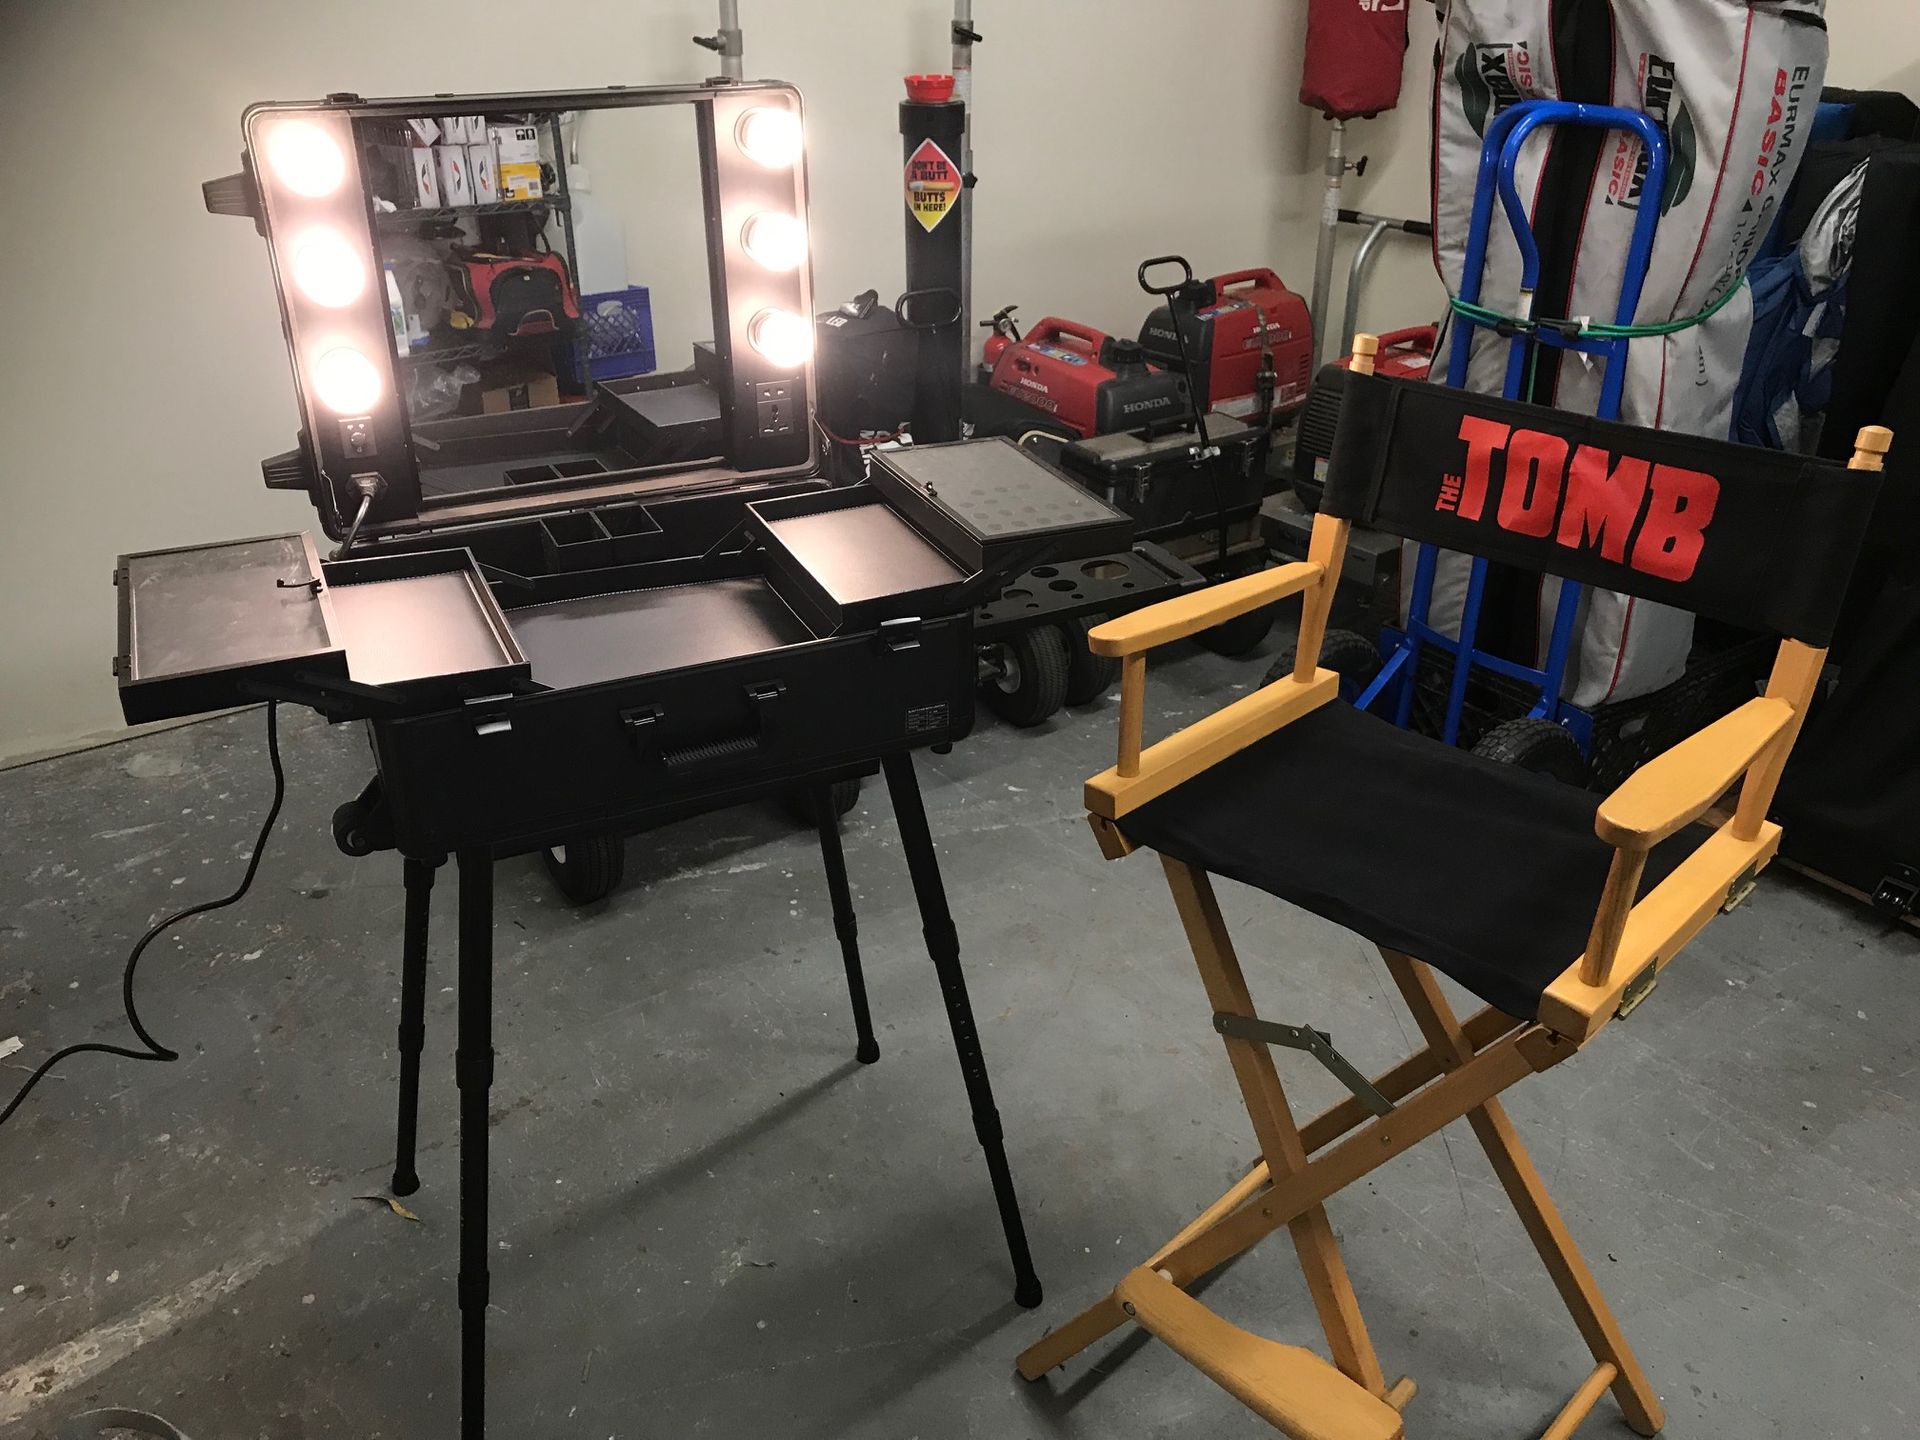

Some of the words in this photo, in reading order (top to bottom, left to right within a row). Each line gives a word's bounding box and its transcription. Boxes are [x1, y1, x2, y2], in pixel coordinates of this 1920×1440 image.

[1751, 68, 1788, 196] BASIC
[1768, 66, 1810, 188] EURMAX
[911, 160, 934, 171] DON'T
[936, 160, 948, 170] BE
[920, 170, 949, 181] BUTT
[913, 191, 946, 203] BUTTS
[913, 203, 921, 212] IN
[923, 203, 946, 212] HERE!
[1149, 326, 1190, 344] HON
[1020, 377, 1049, 394] HONDA
[1123, 396, 1171, 414] HONDA
[1434, 473, 1462, 512] THE
[1456, 414, 1721, 583] TOMB
